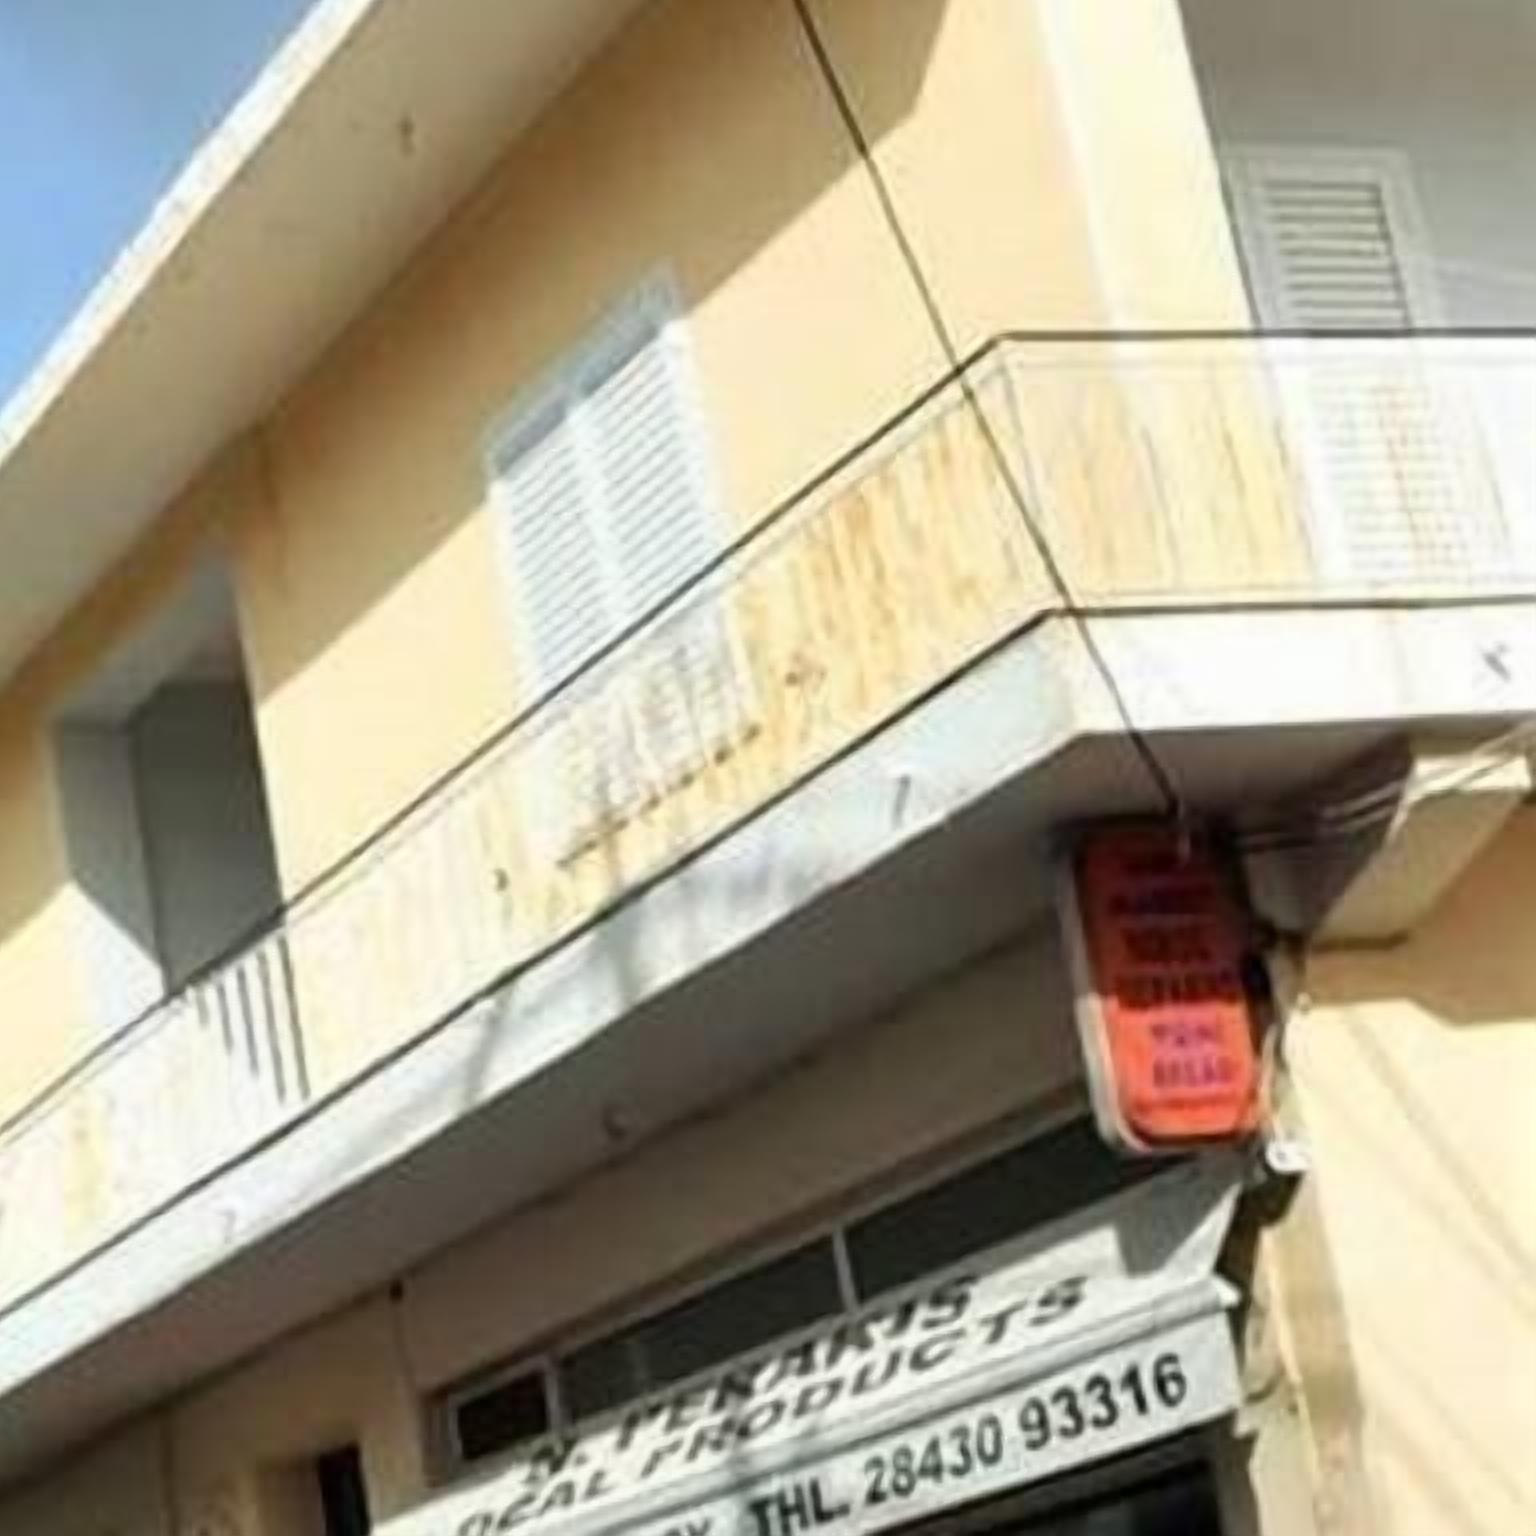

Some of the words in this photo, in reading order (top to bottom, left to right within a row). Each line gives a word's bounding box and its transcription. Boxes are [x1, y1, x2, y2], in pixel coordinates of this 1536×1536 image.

[640, 1275, 1088, 1479] PRODUCTS
[864, 1413, 1005, 1507] 28430
[1018, 1351, 1187, 1452] 93316
